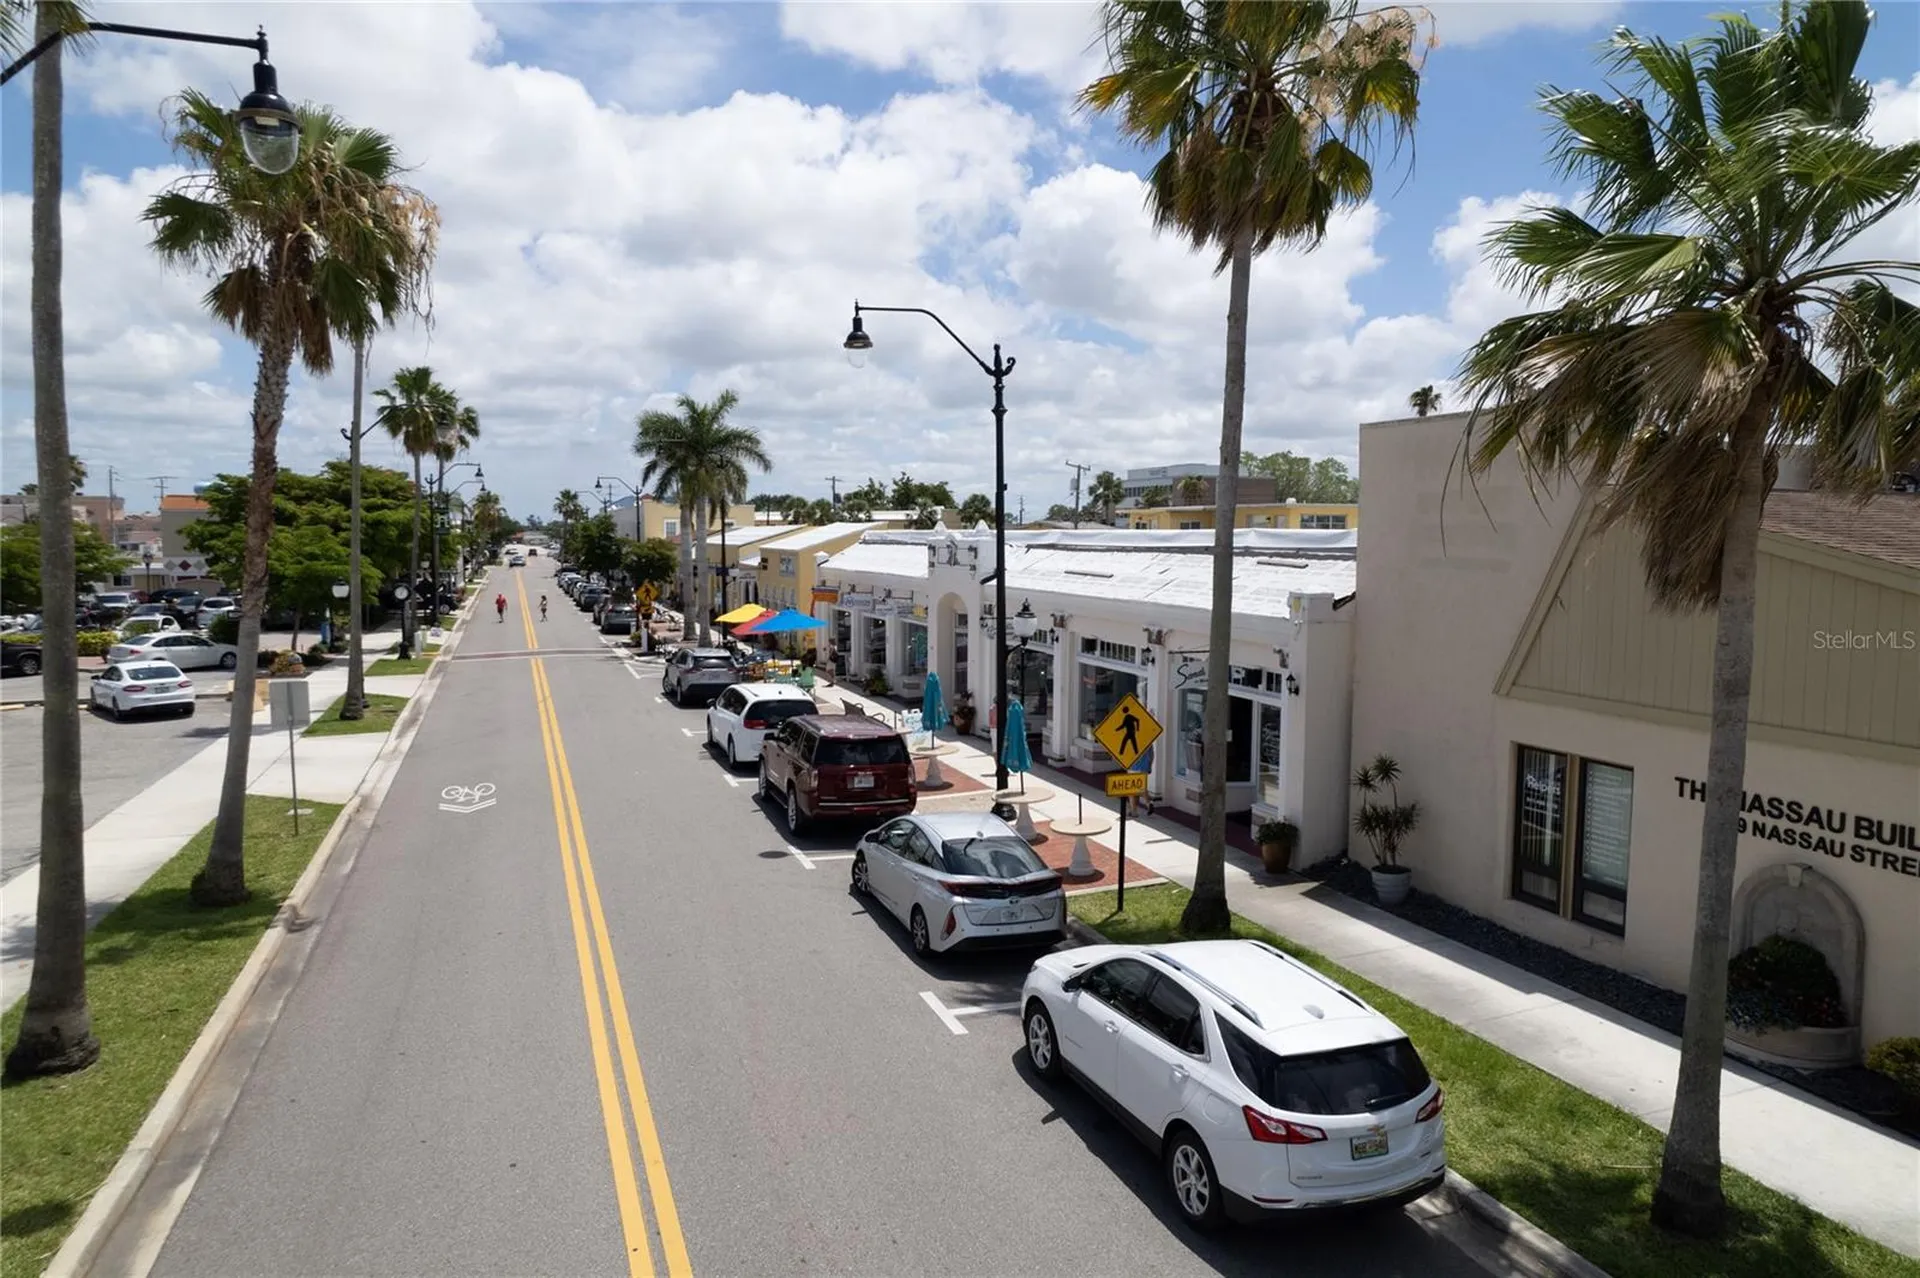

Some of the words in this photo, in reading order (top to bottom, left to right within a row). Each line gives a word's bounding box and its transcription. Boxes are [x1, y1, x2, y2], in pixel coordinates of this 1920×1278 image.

[1111, 778, 1143, 791] AHEAD
[1674, 776, 1707, 802] TH
[1853, 815, 1920, 852] BUIL
[1752, 820, 1845, 858] NASSAU
[1849, 844, 1920, 878] STRE
